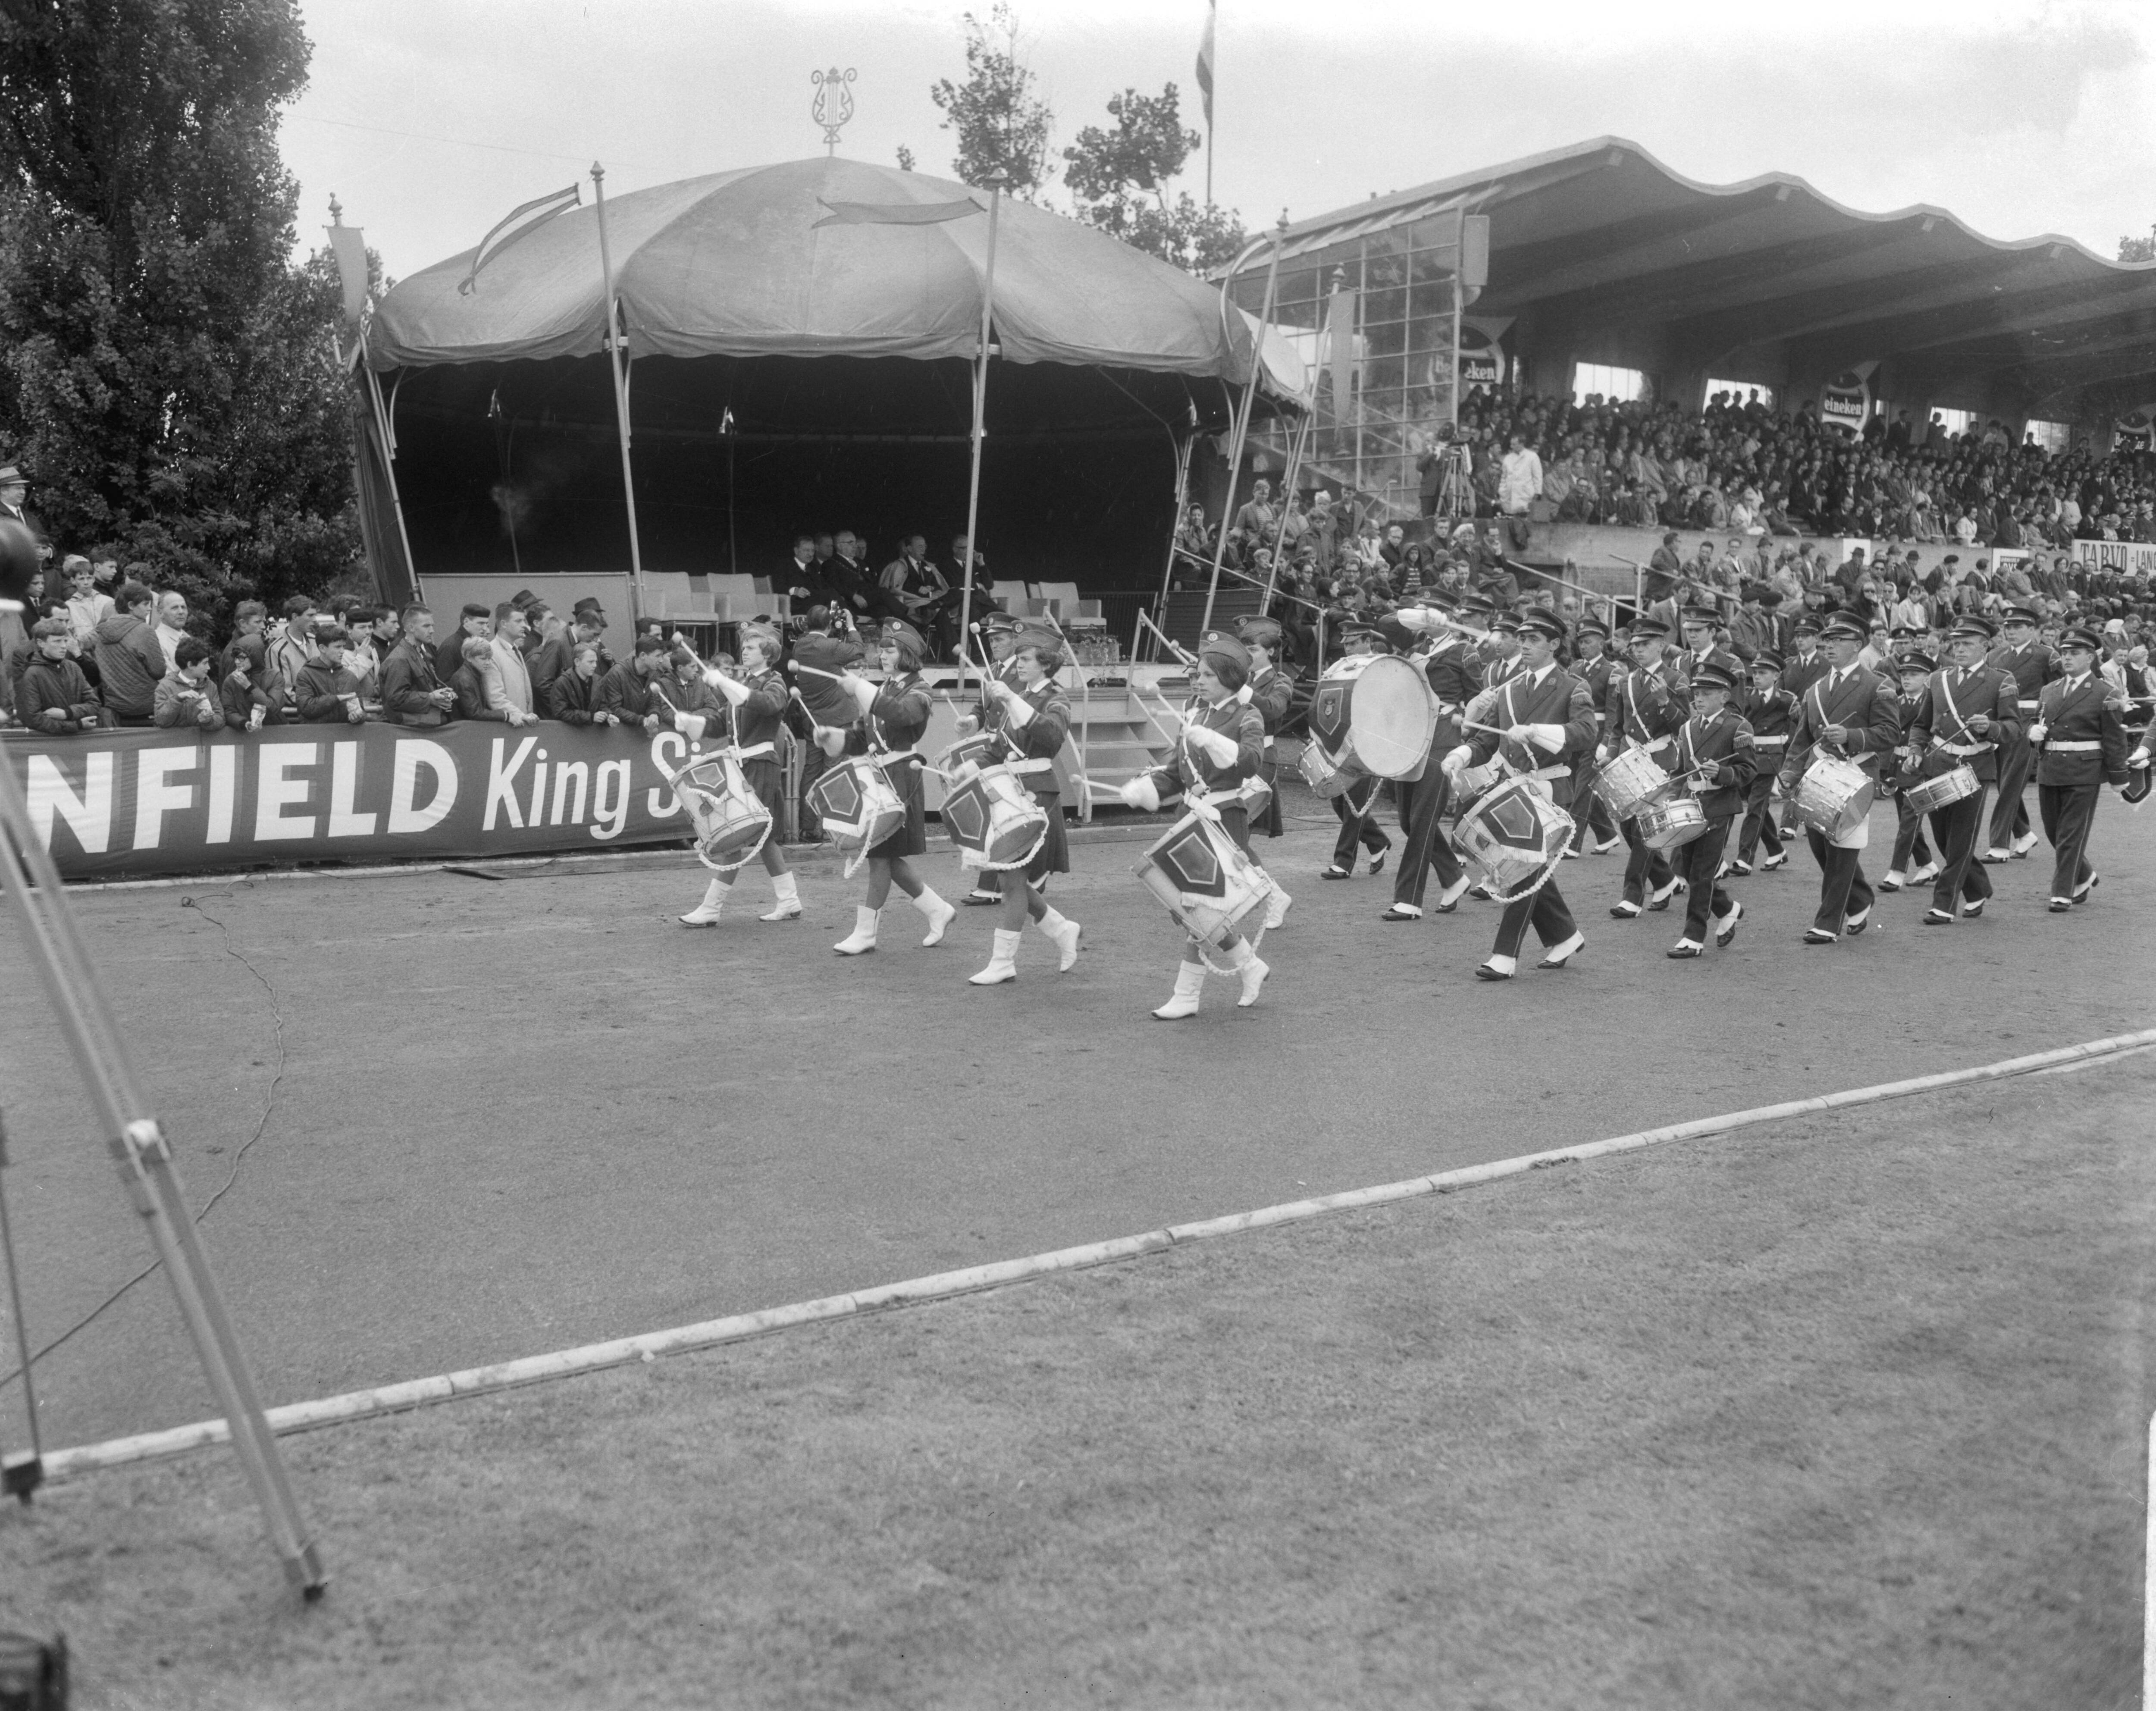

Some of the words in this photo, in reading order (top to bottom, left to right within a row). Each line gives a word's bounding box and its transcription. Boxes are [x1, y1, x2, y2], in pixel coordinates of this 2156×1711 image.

[2081, 543, 2128, 571] TARVO
[2137, 550, 2156, 570] LAN
[22, 738, 458, 857] NFIELD
[483, 736, 631, 840] King
